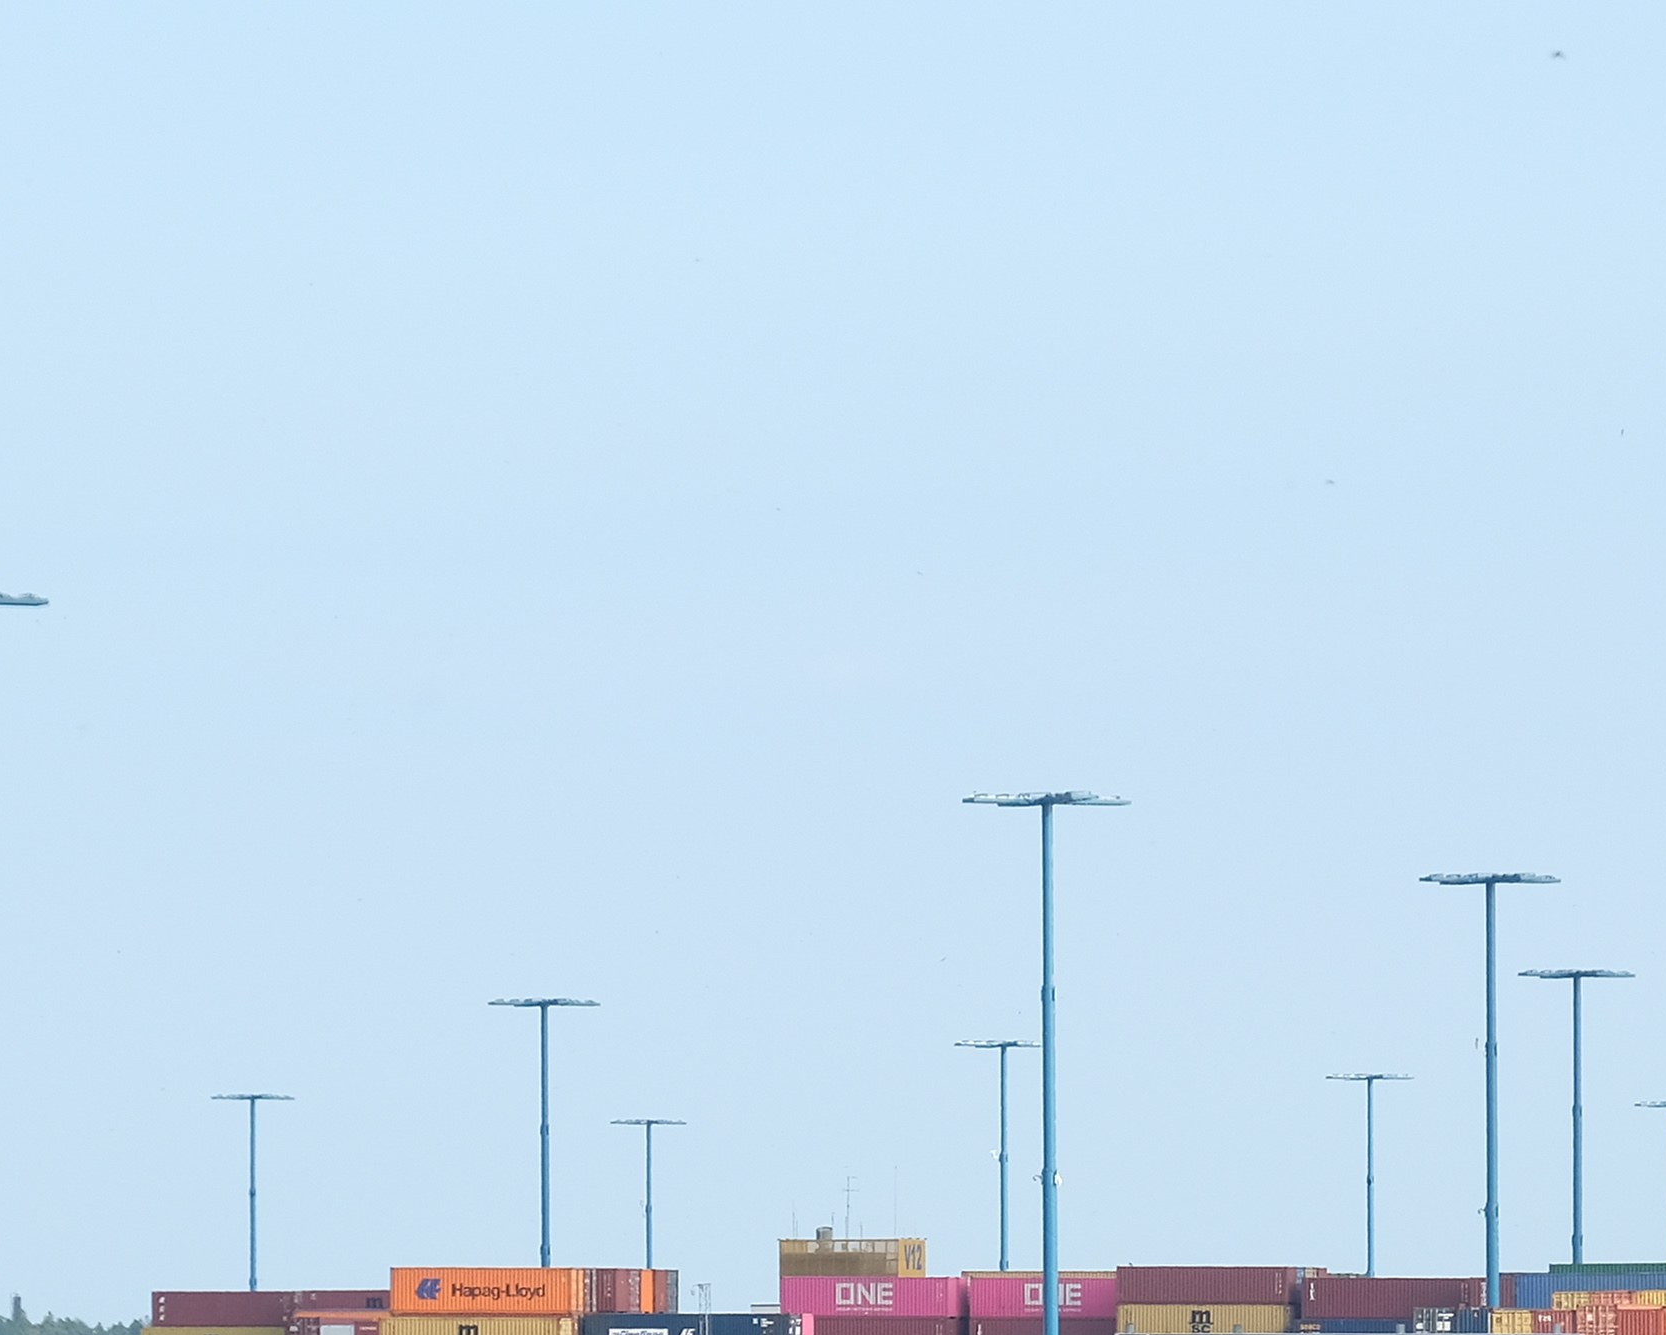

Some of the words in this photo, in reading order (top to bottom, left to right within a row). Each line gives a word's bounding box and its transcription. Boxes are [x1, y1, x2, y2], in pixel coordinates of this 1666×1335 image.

[904, 1244, 923, 1270] V12
[451, 1282, 546, 1300] Hapag-Lloyd
[836, 1283, 893, 1305] ONE
